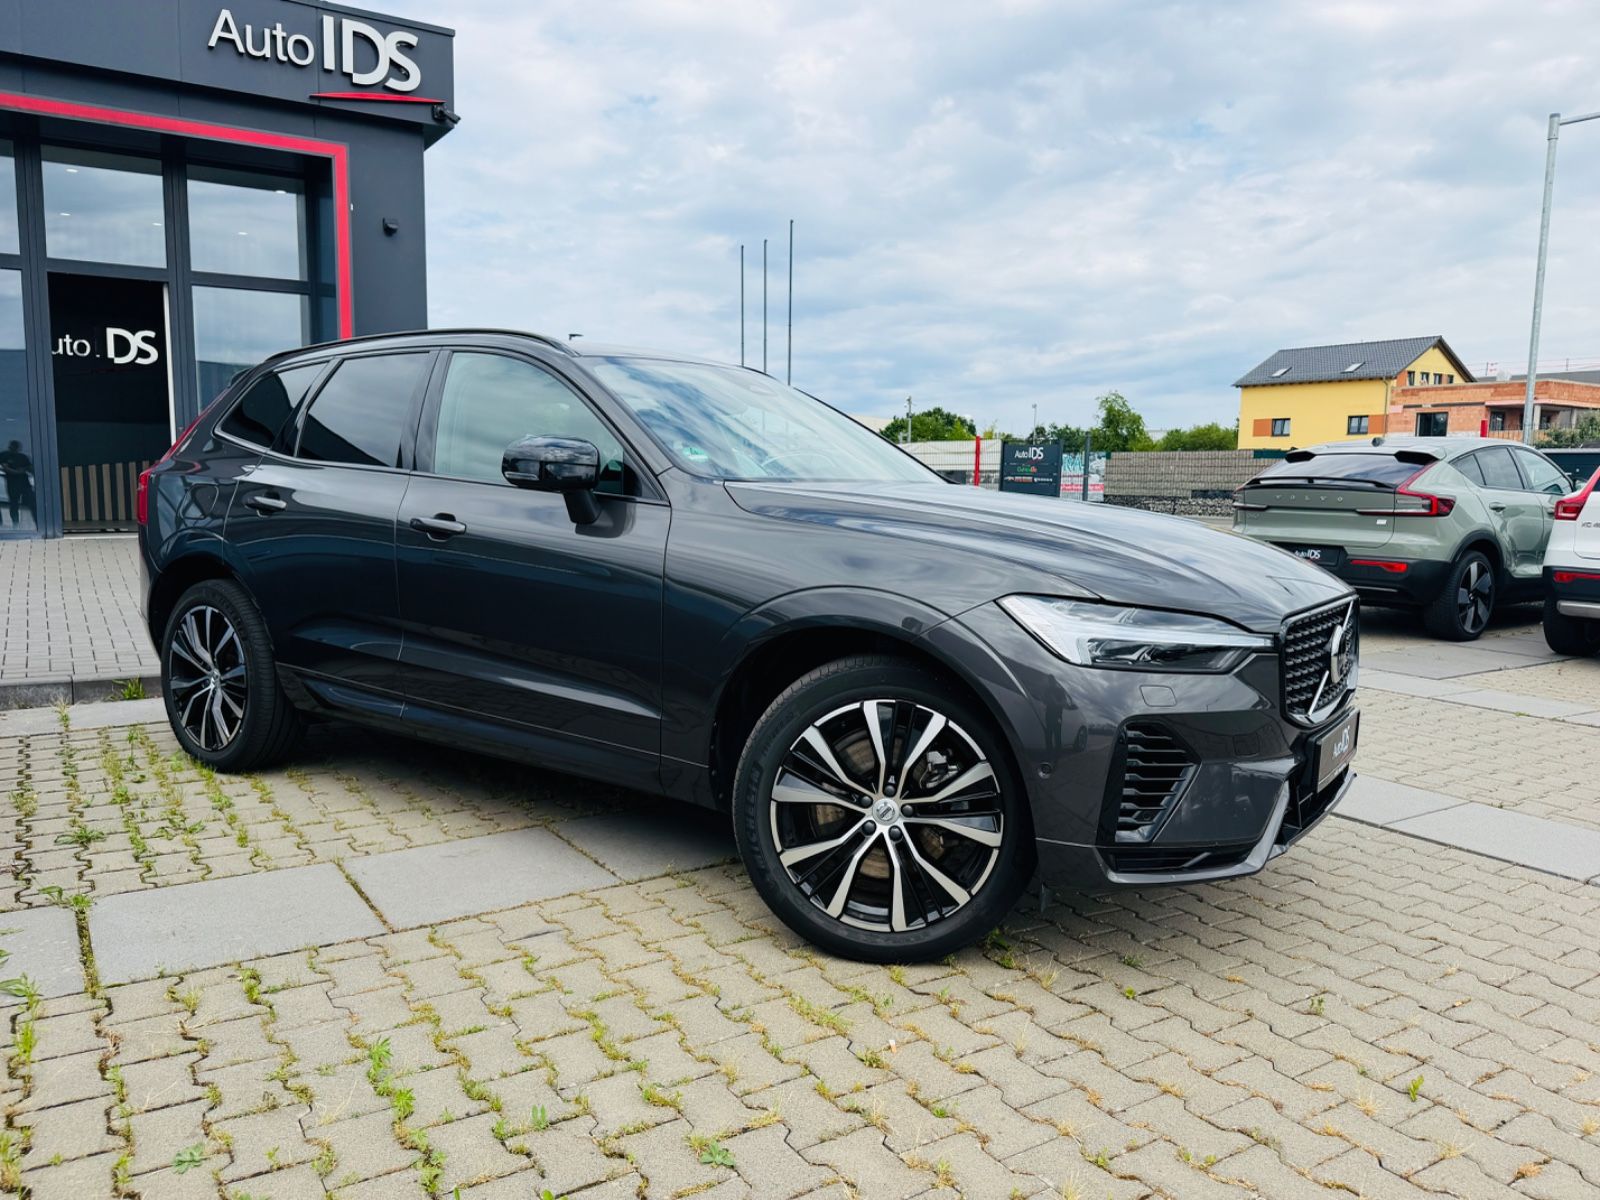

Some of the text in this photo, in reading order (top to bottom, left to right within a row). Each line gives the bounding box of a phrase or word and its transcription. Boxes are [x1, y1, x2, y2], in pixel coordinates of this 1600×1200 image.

[207, 8, 421, 93] Auto IDS
[51, 334, 91, 357] uto
